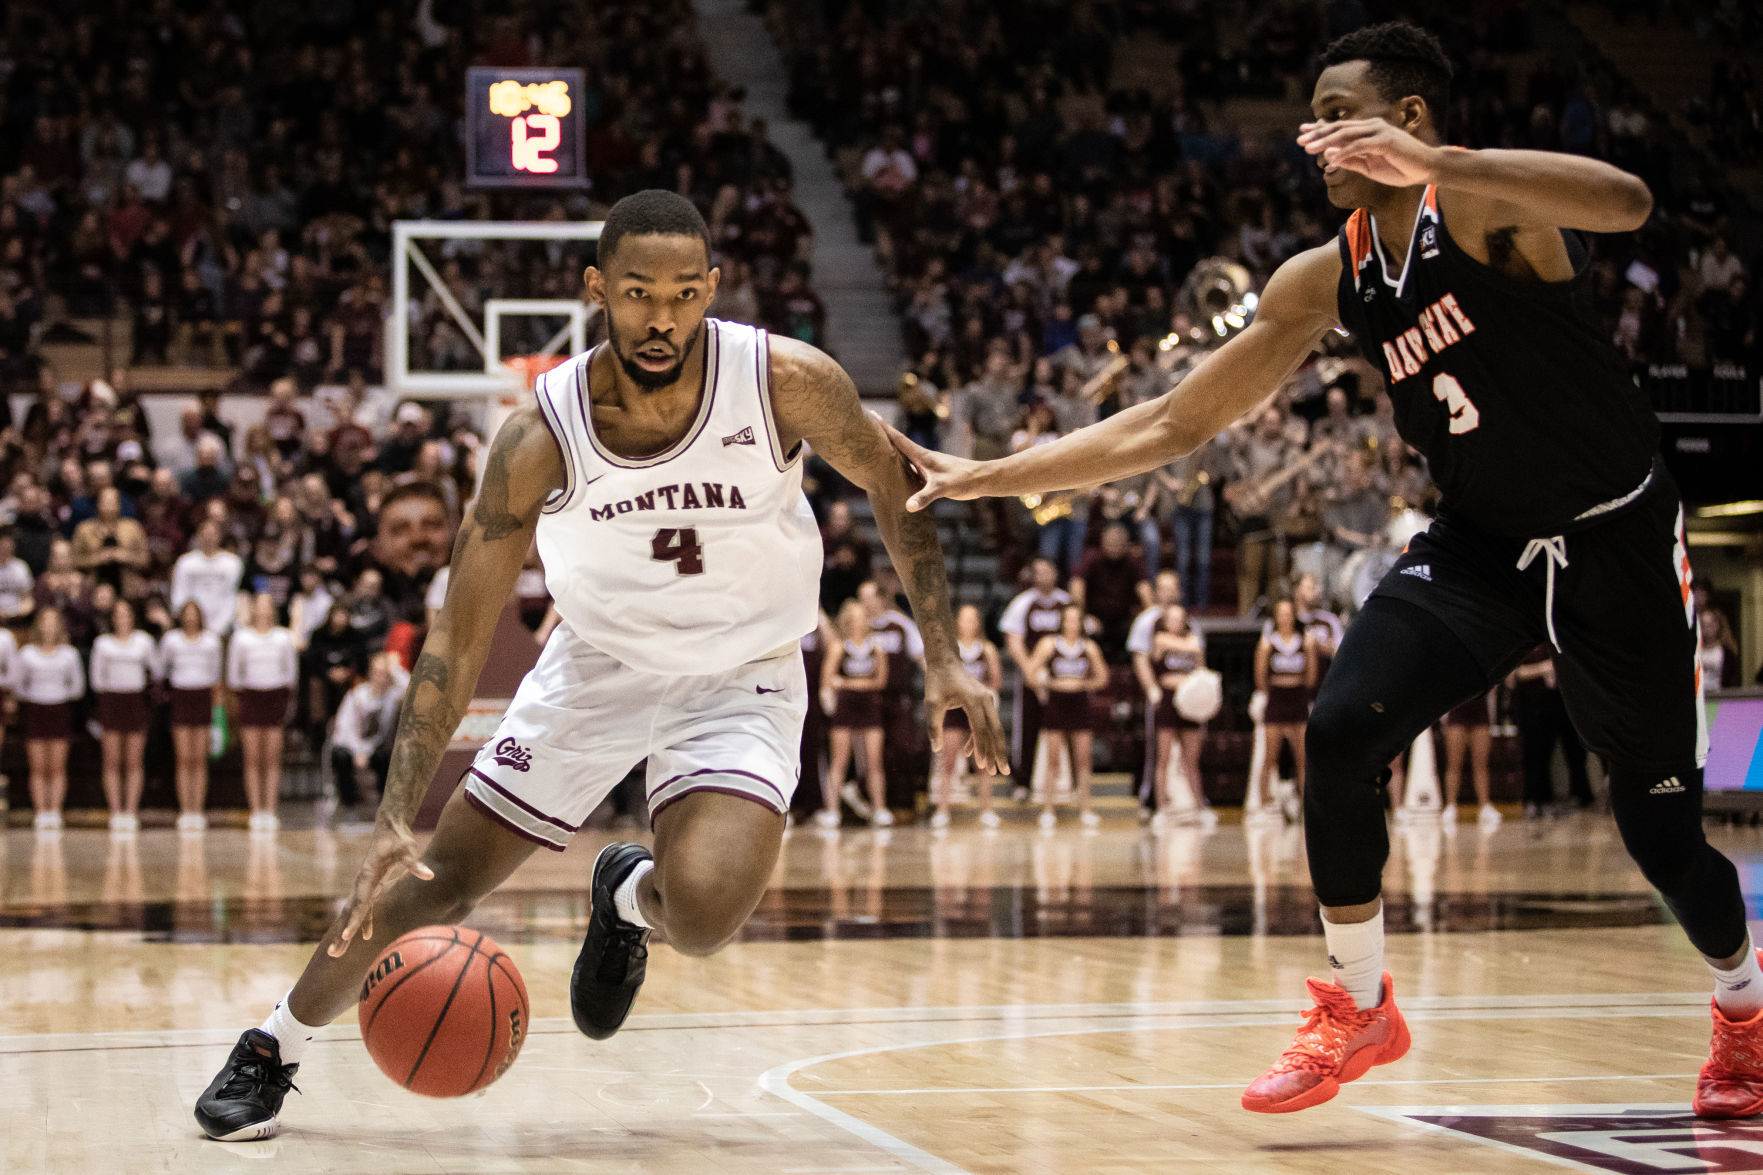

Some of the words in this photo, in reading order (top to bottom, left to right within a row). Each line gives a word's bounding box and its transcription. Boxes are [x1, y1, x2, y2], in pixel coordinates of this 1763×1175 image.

[511, 114, 561, 174] 12
[1432, 372, 1480, 435] 3
[734, 427, 754, 443] SKY
[589, 482, 747, 522] MONTANA
[649, 525, 706, 577] 4
[496, 736, 533, 772] Griz
[1649, 785, 1686, 794] adidas
